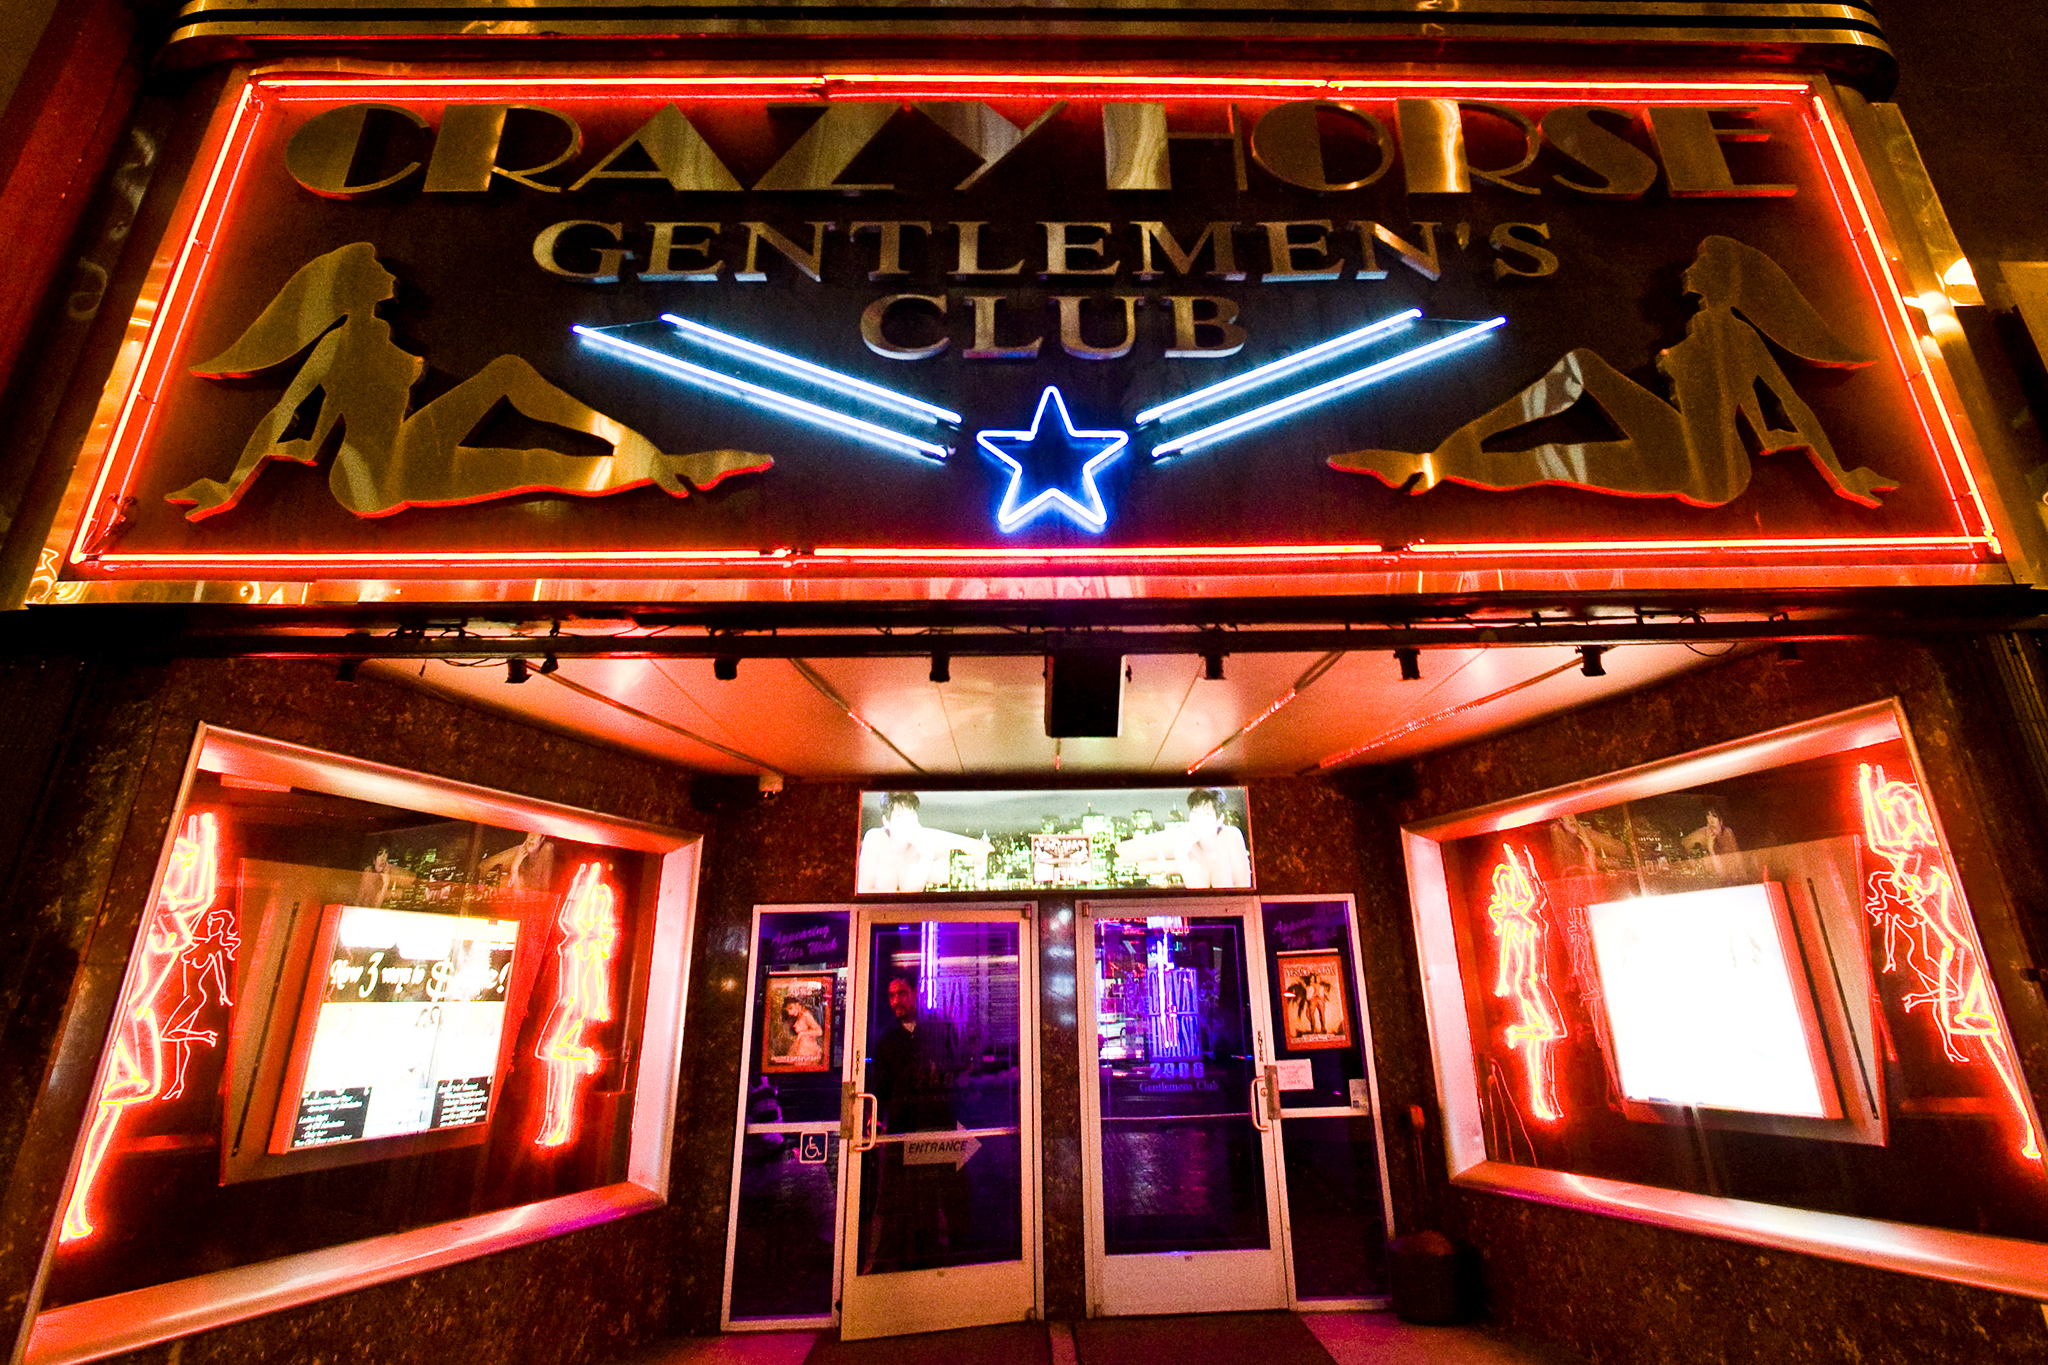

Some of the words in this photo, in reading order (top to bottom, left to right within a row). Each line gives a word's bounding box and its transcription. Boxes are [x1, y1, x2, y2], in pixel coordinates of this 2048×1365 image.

[532, 219, 1560, 284] GENTLEMEN'S
[860, 293, 1247, 361] CLUB
[770, 925, 830, 946] Appearing
[358, 952, 385, 999] 3
[1139, 1081, 1194, 1092] Gentlemens
[1196, 1080, 1219, 1091] Club
[908, 1141, 968, 1154] ENTRANCE
